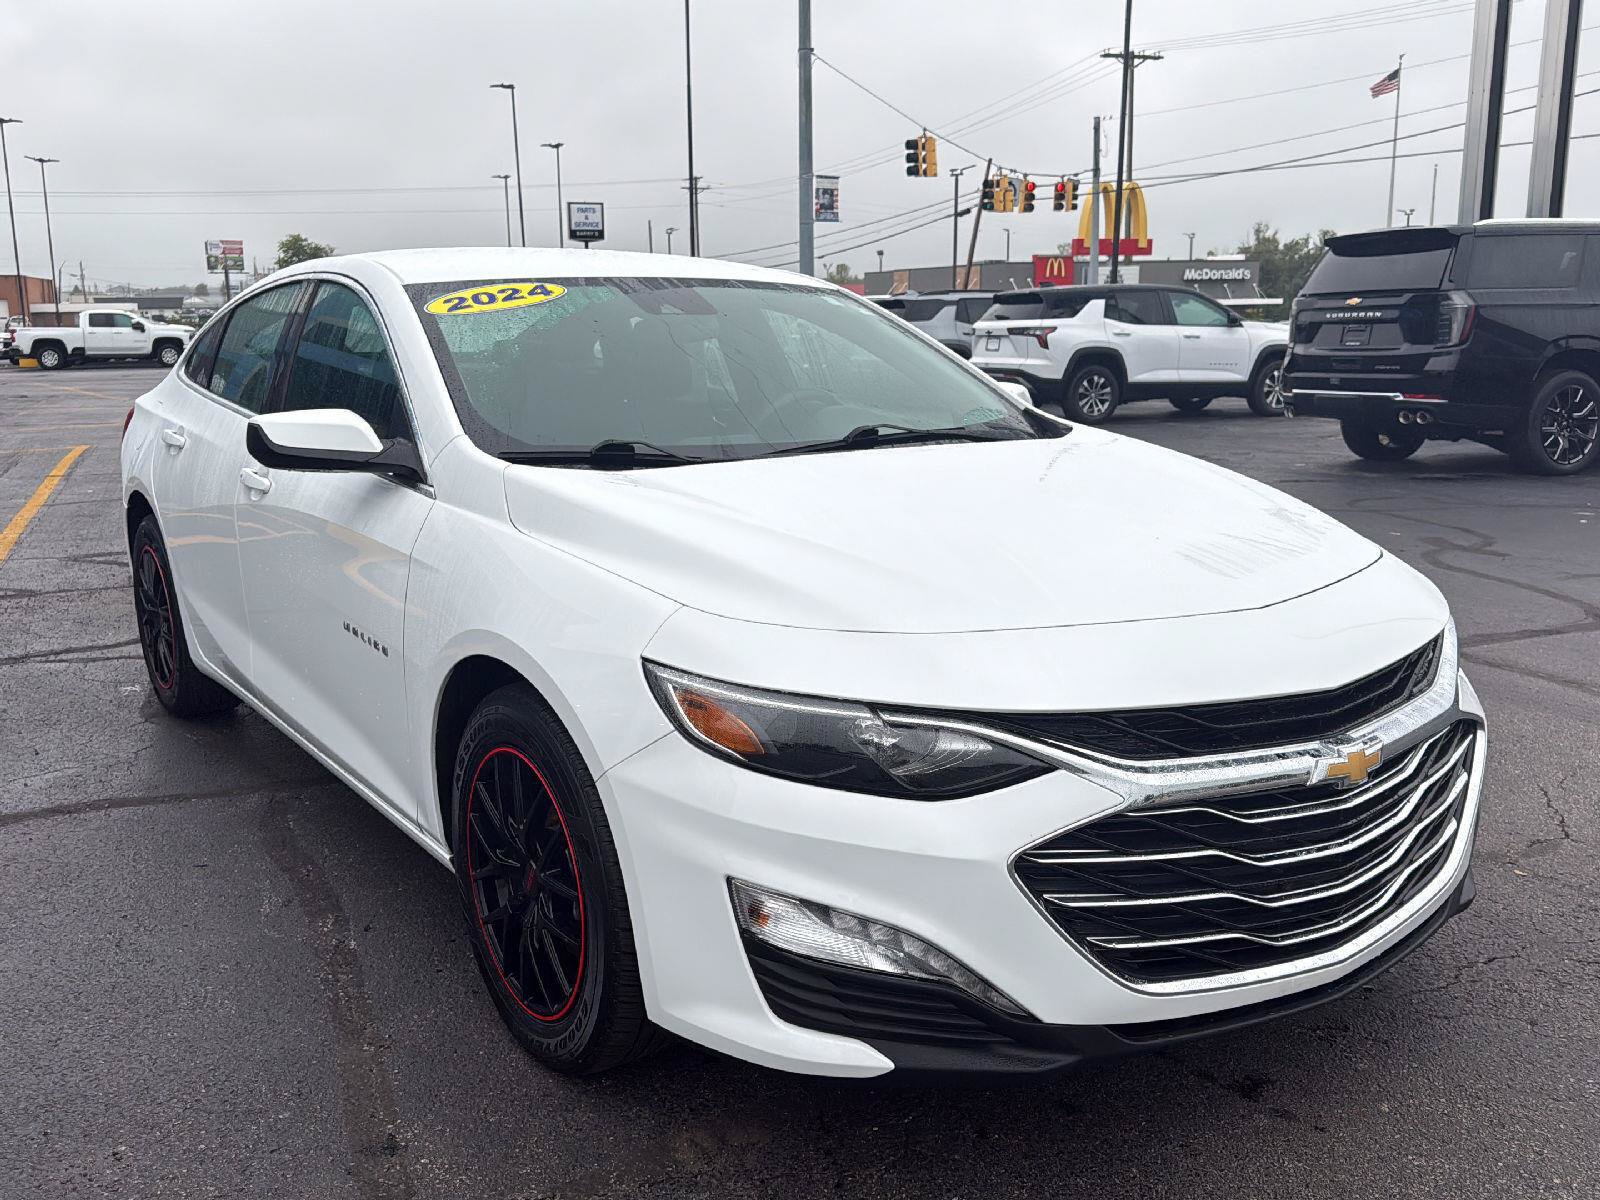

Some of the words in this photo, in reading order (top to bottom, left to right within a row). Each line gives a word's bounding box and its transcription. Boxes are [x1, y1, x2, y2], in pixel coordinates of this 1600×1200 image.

[576, 207, 596, 215] PARTS
[1184, 268, 1251, 280] McDonald's
[442, 284, 555, 313] 2024
